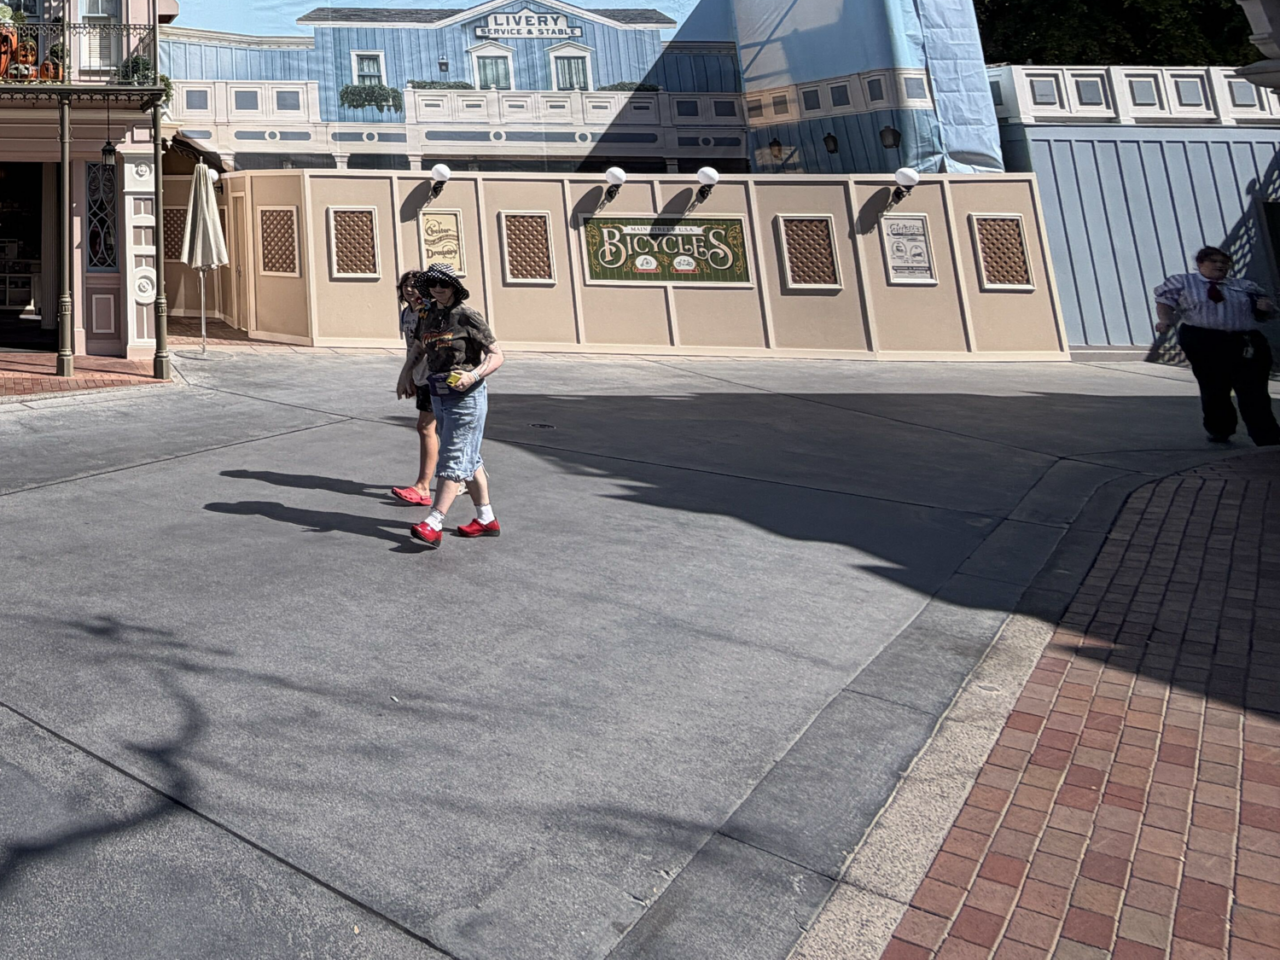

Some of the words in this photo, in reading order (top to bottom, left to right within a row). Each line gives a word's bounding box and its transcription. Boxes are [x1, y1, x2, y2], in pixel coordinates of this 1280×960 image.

[494, 15, 561, 26] LIVERY
[480, 28, 523, 36] SERVICE
[526, 28, 534, 36] &
[537, 28, 577, 36] STABLE
[598, 227, 734, 270] BICYCLES
